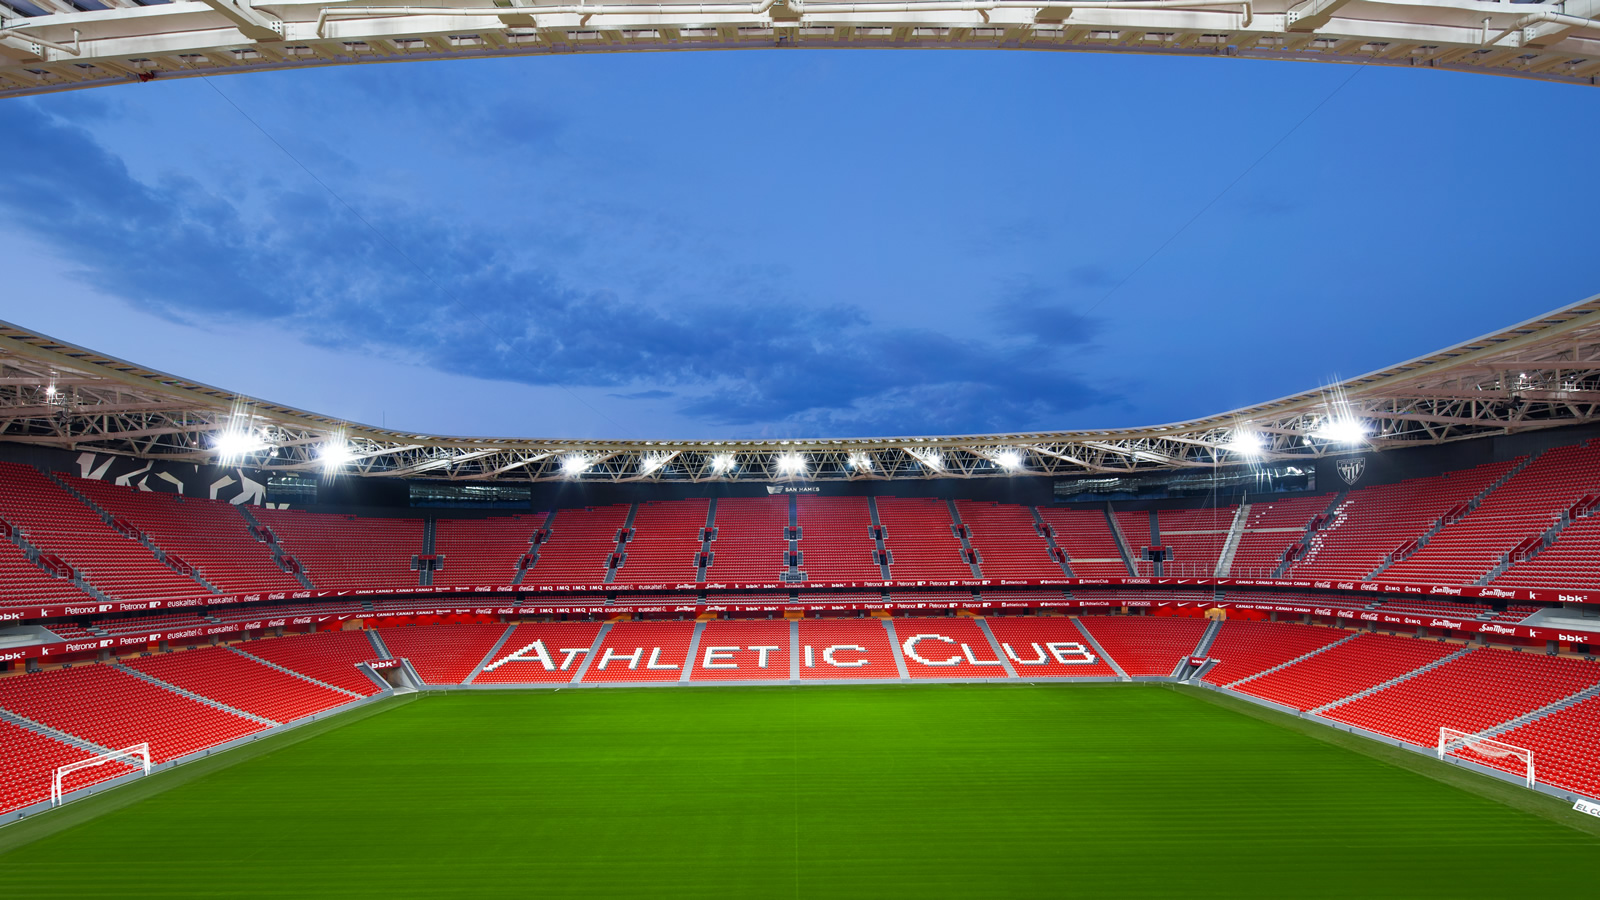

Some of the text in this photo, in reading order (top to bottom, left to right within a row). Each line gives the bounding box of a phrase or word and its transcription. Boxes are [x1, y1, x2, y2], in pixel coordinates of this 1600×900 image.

[208, 596, 234, 604] euskaltel
[1559, 594, 1583, 602] bbk
[168, 599, 196, 607] euskaltel
[65, 606, 96, 614] Petronor
[208, 625, 234, 634] euskaltel
[168, 629, 197, 639] euskaltel
[1559, 634, 1583, 642] bbk
[120, 636, 147, 645] Petronor
[66, 642, 97, 651] Petronor
[902, 634, 1099, 667] CLUB
[1576, 804, 1588, 812] EL
